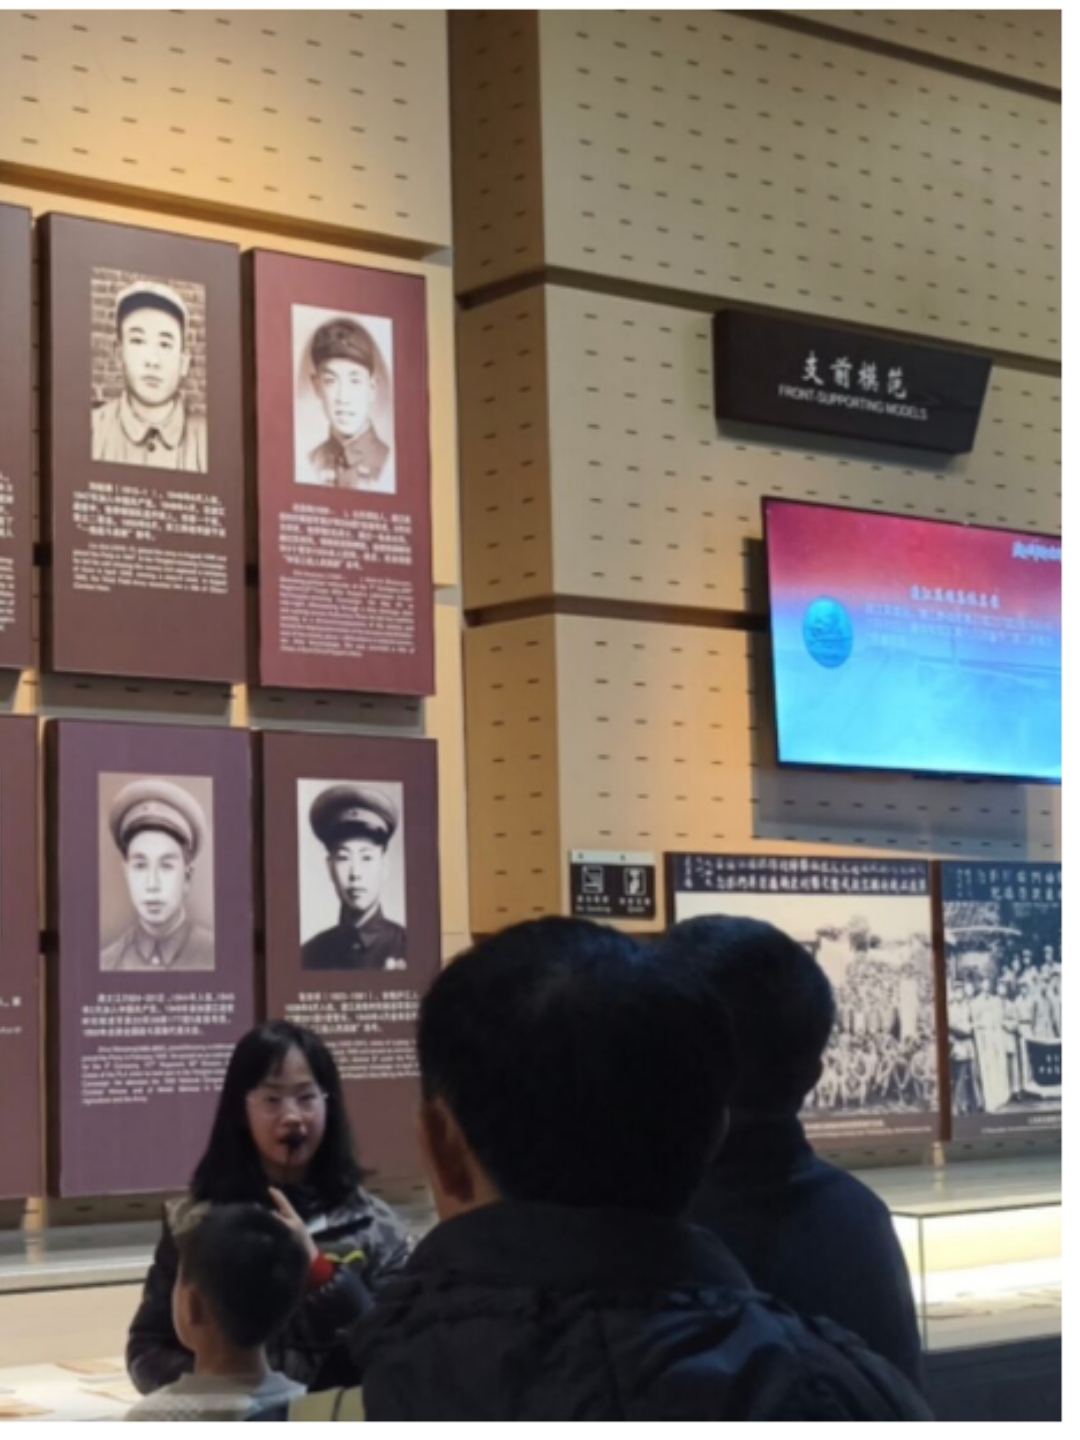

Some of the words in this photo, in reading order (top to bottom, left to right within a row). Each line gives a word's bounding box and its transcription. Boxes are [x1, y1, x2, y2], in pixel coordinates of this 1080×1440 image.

[801, 350, 907, 399] 支前模范
[778, 383, 885, 414] FRONT-SUPPORTING
[886, 401, 928, 421] MODELS
